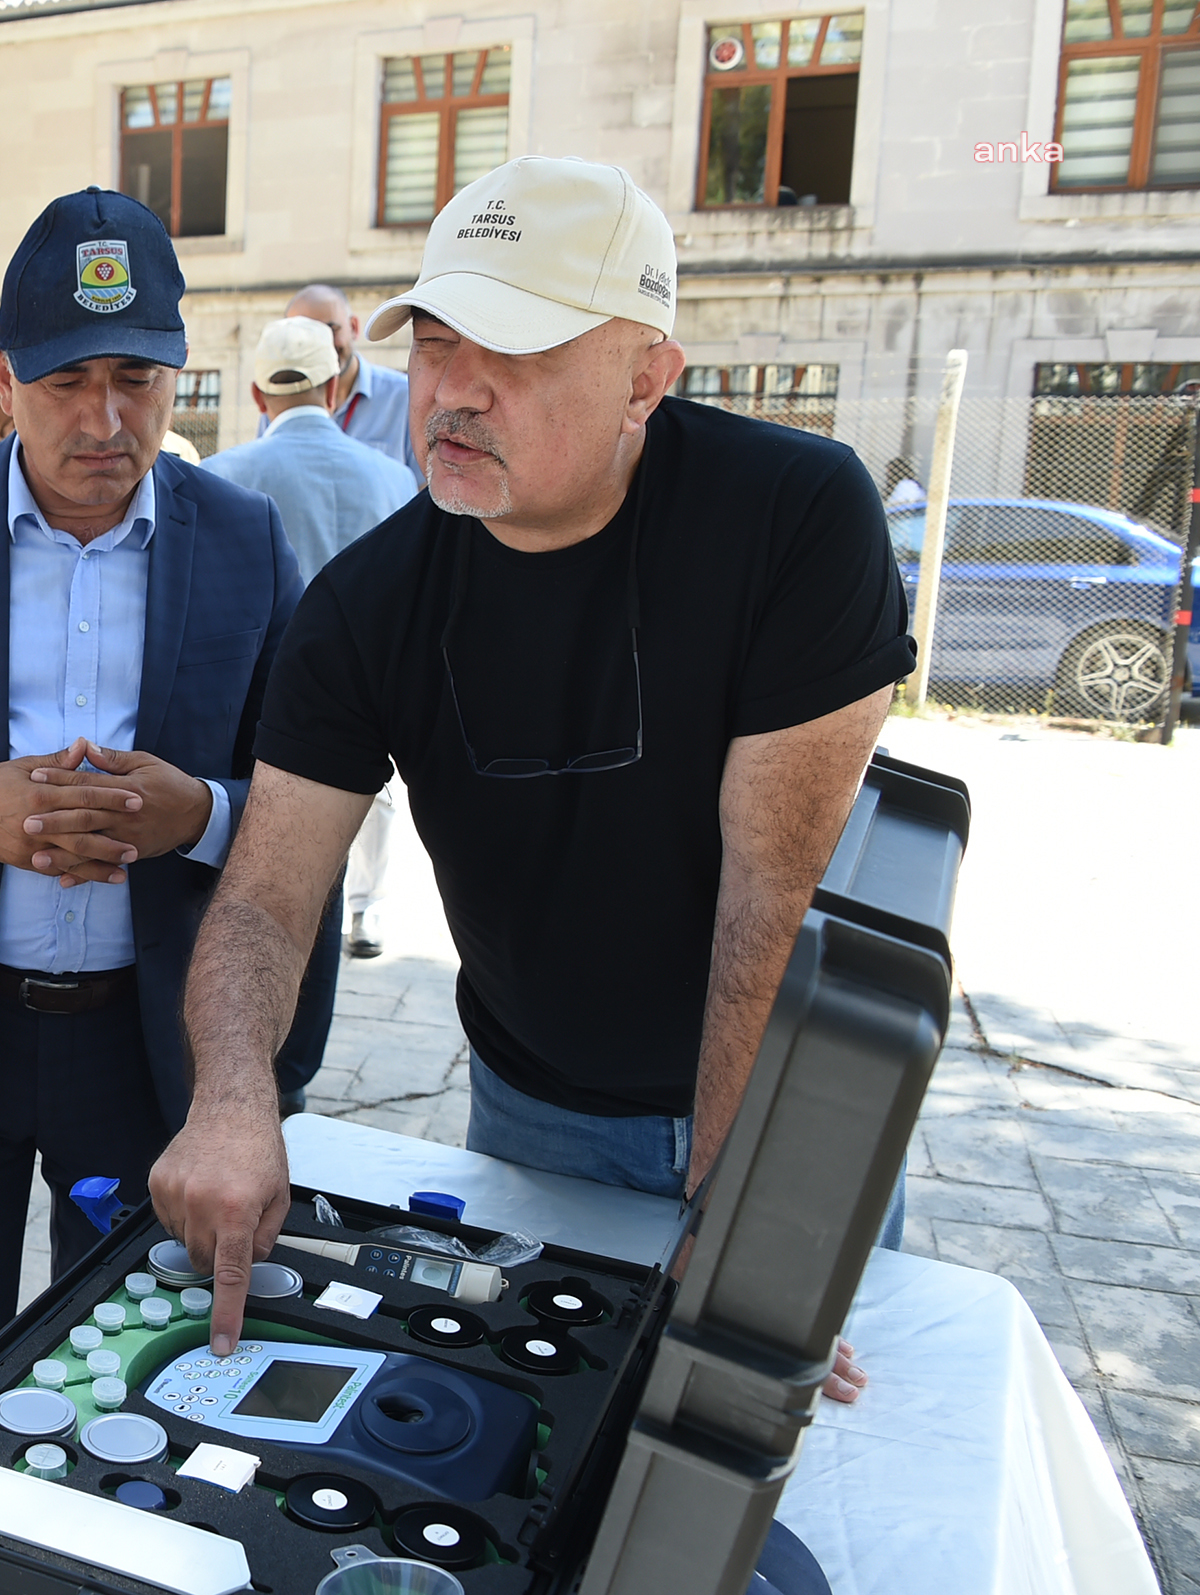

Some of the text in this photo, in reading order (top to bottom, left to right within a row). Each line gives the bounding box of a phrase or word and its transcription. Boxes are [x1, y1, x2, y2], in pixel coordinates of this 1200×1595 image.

[486, 199, 506, 211] T.C.
[471, 213, 516, 226] TARSUS
[456, 226, 522, 242] BELEDİYESİ
[81, 247, 123, 257] TARSUS
[399, 1254, 413, 1280] Palintes
[333, 1381, 362, 1409] Palintest
